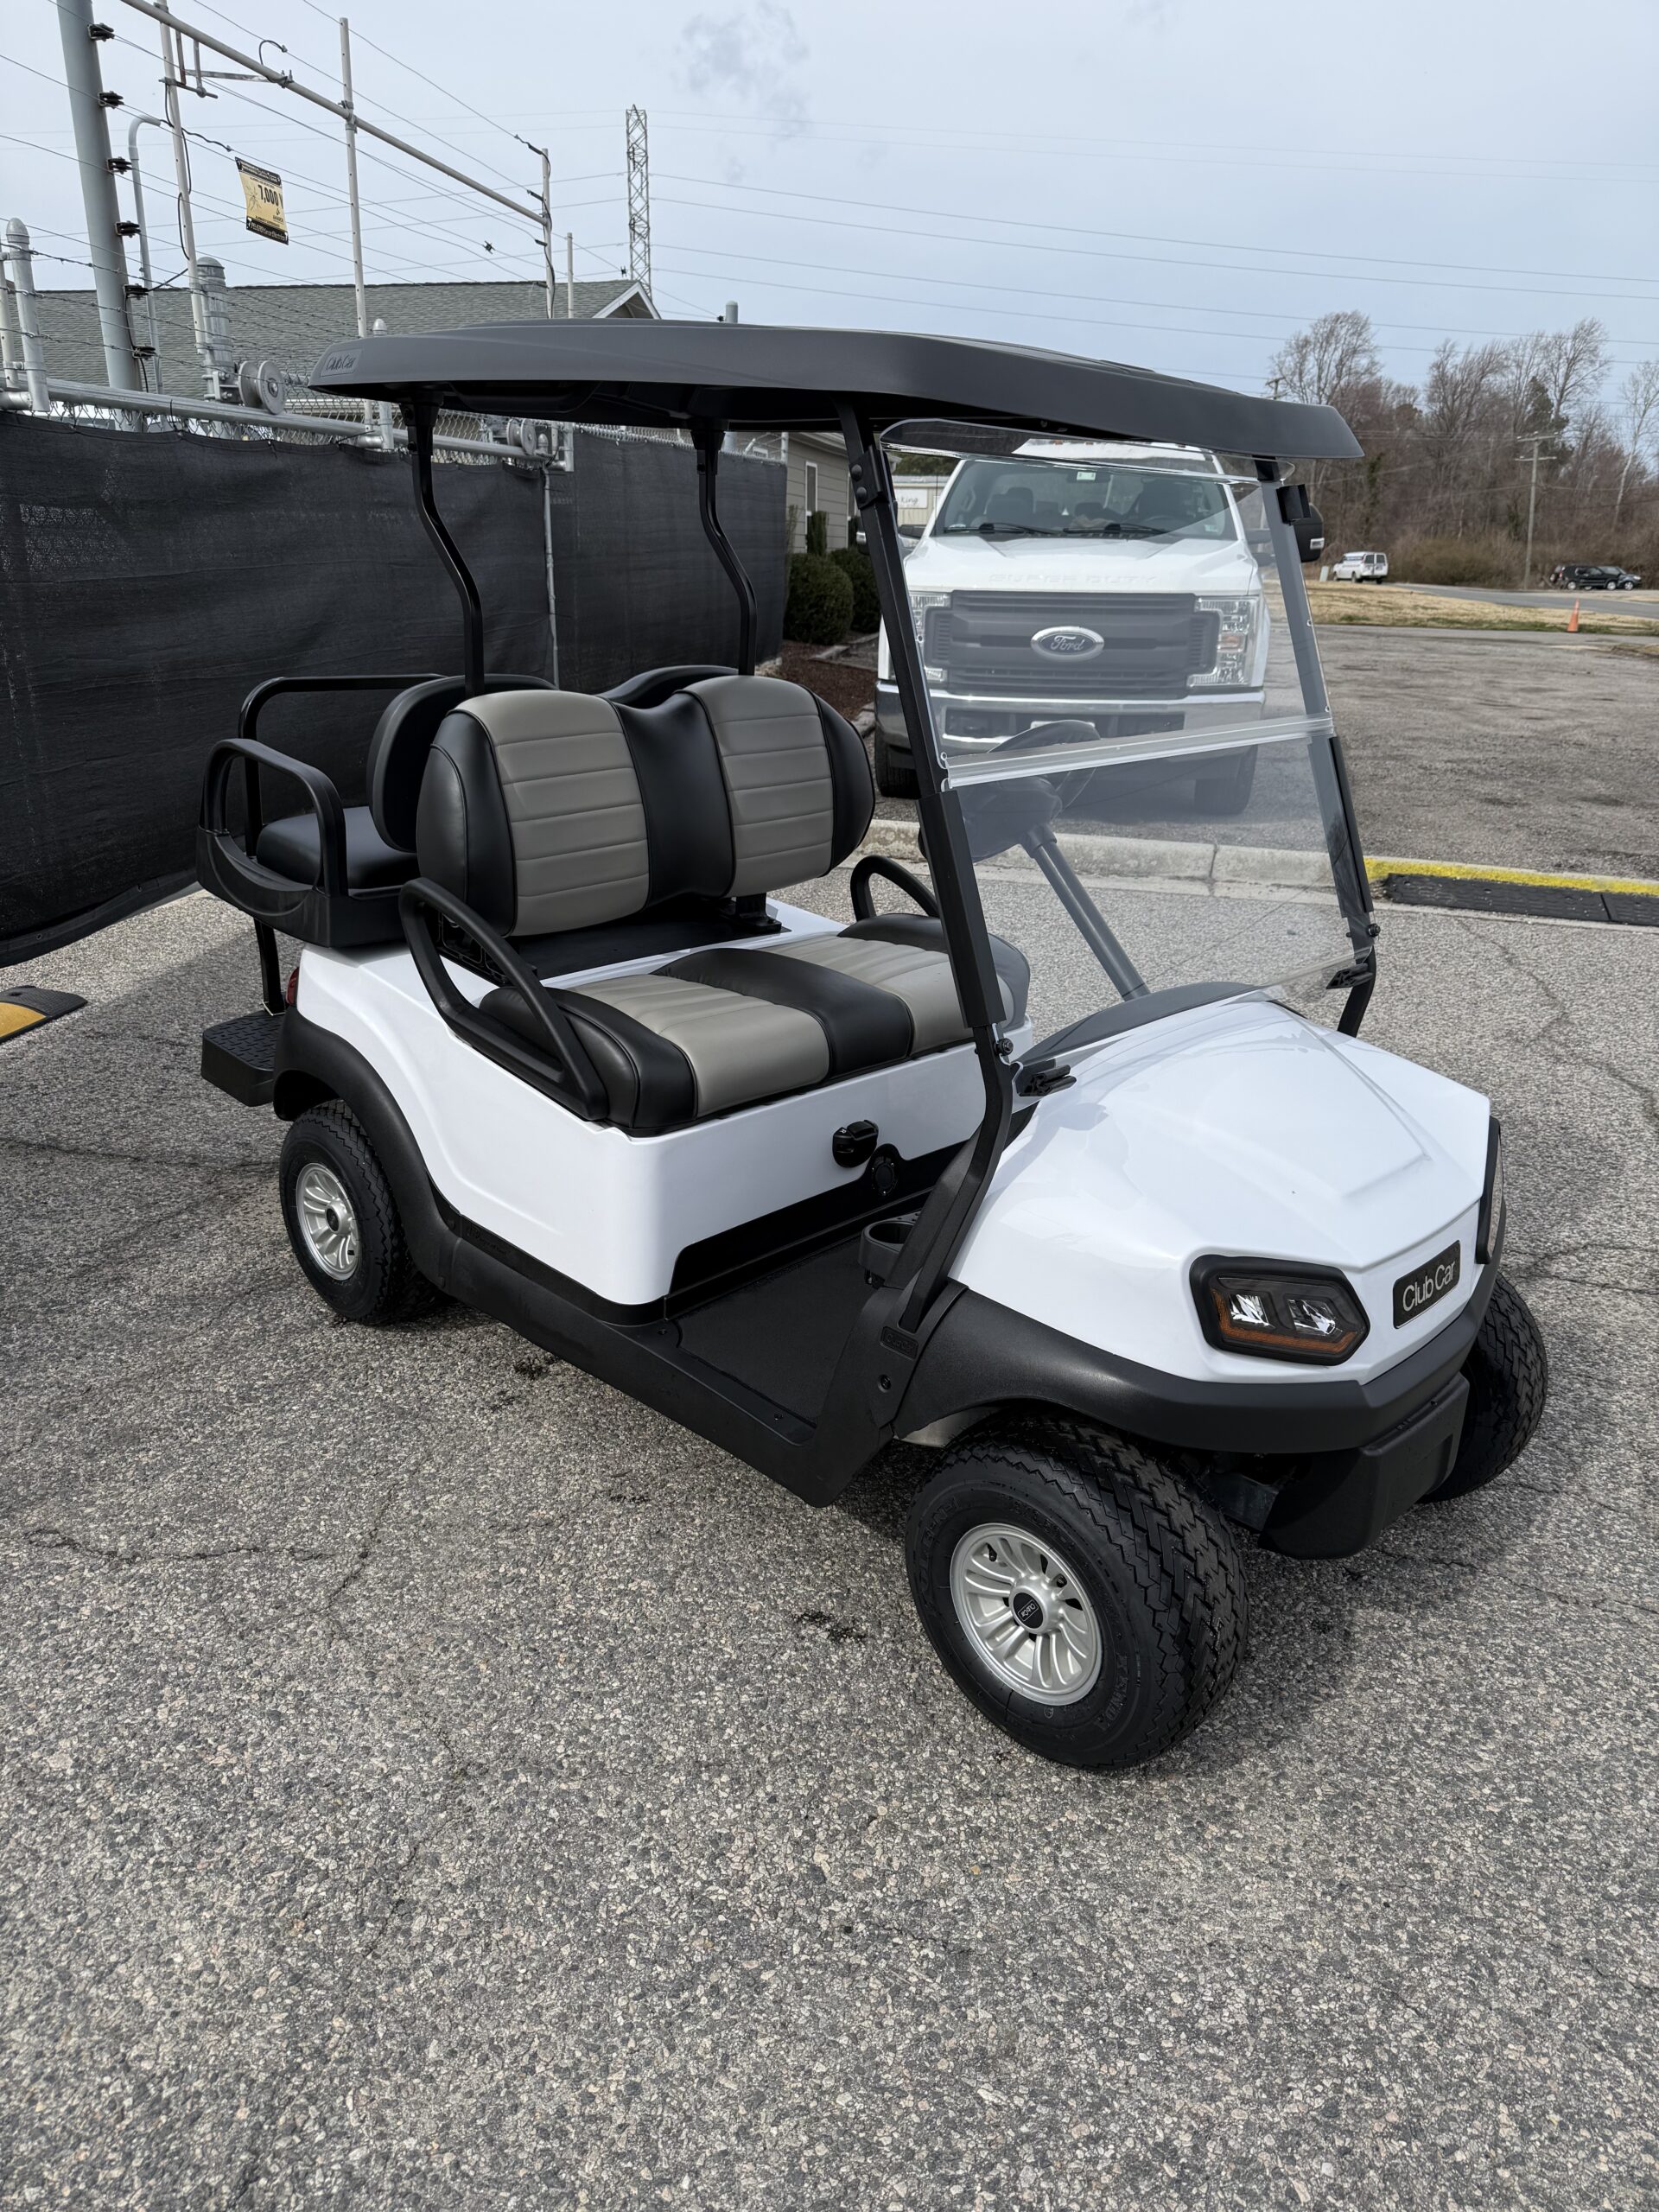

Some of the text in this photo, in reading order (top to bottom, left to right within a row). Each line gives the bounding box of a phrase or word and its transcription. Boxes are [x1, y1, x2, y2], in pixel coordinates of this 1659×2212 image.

[257, 184, 279, 207] 7,000
[1050, 635, 1085, 651] Ford
[1402, 1261, 1456, 1312] Club Car
